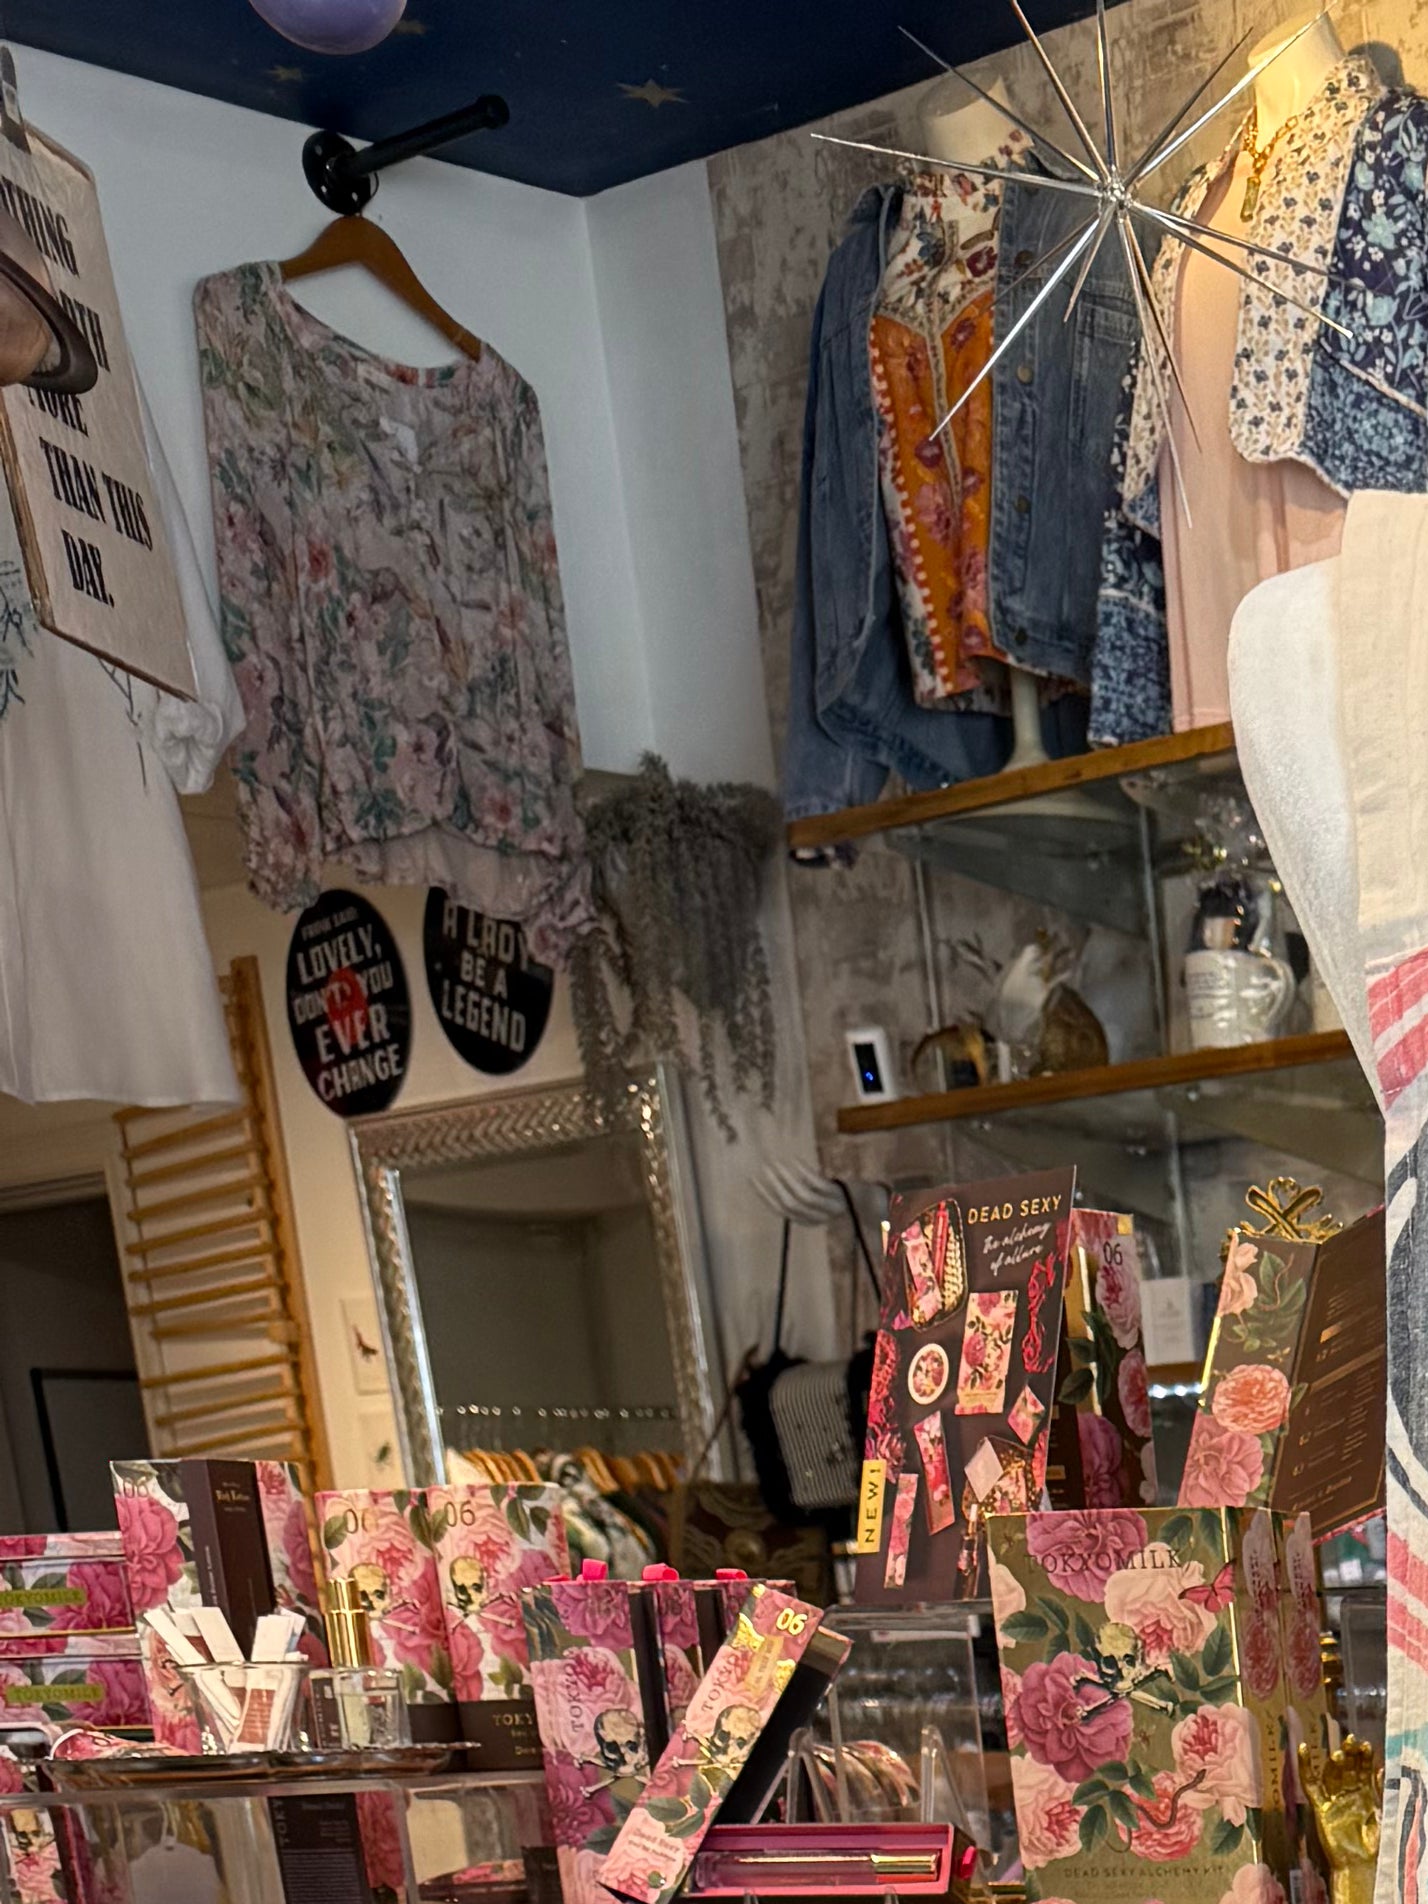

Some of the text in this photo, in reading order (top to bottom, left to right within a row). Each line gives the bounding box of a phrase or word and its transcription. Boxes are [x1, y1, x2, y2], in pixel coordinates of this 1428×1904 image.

[39, 436, 154, 552] THAN THIS
[61, 528, 115, 609] DAY.
[442, 900, 459, 939] A
[296, 923, 383, 986] LOVELY,
[460, 949, 509, 1000] BE A
[356, 961, 394, 997] YOU
[314, 1003, 391, 1064] EVER
[440, 979, 528, 1053] LEGEND
[316, 1043, 405, 1102] CHANGE
[967, 1194, 1062, 1225] DEAD SEXY
[1102, 1241, 1124, 1267] 06
[445, 1501, 476, 1527] 06
[864, 1466, 883, 1544] NEW!
[1027, 1547, 1182, 1575] TOKYOMILK
[0, 1590, 83, 1604] OKYOMILK
[775, 1607, 809, 1636] 06
